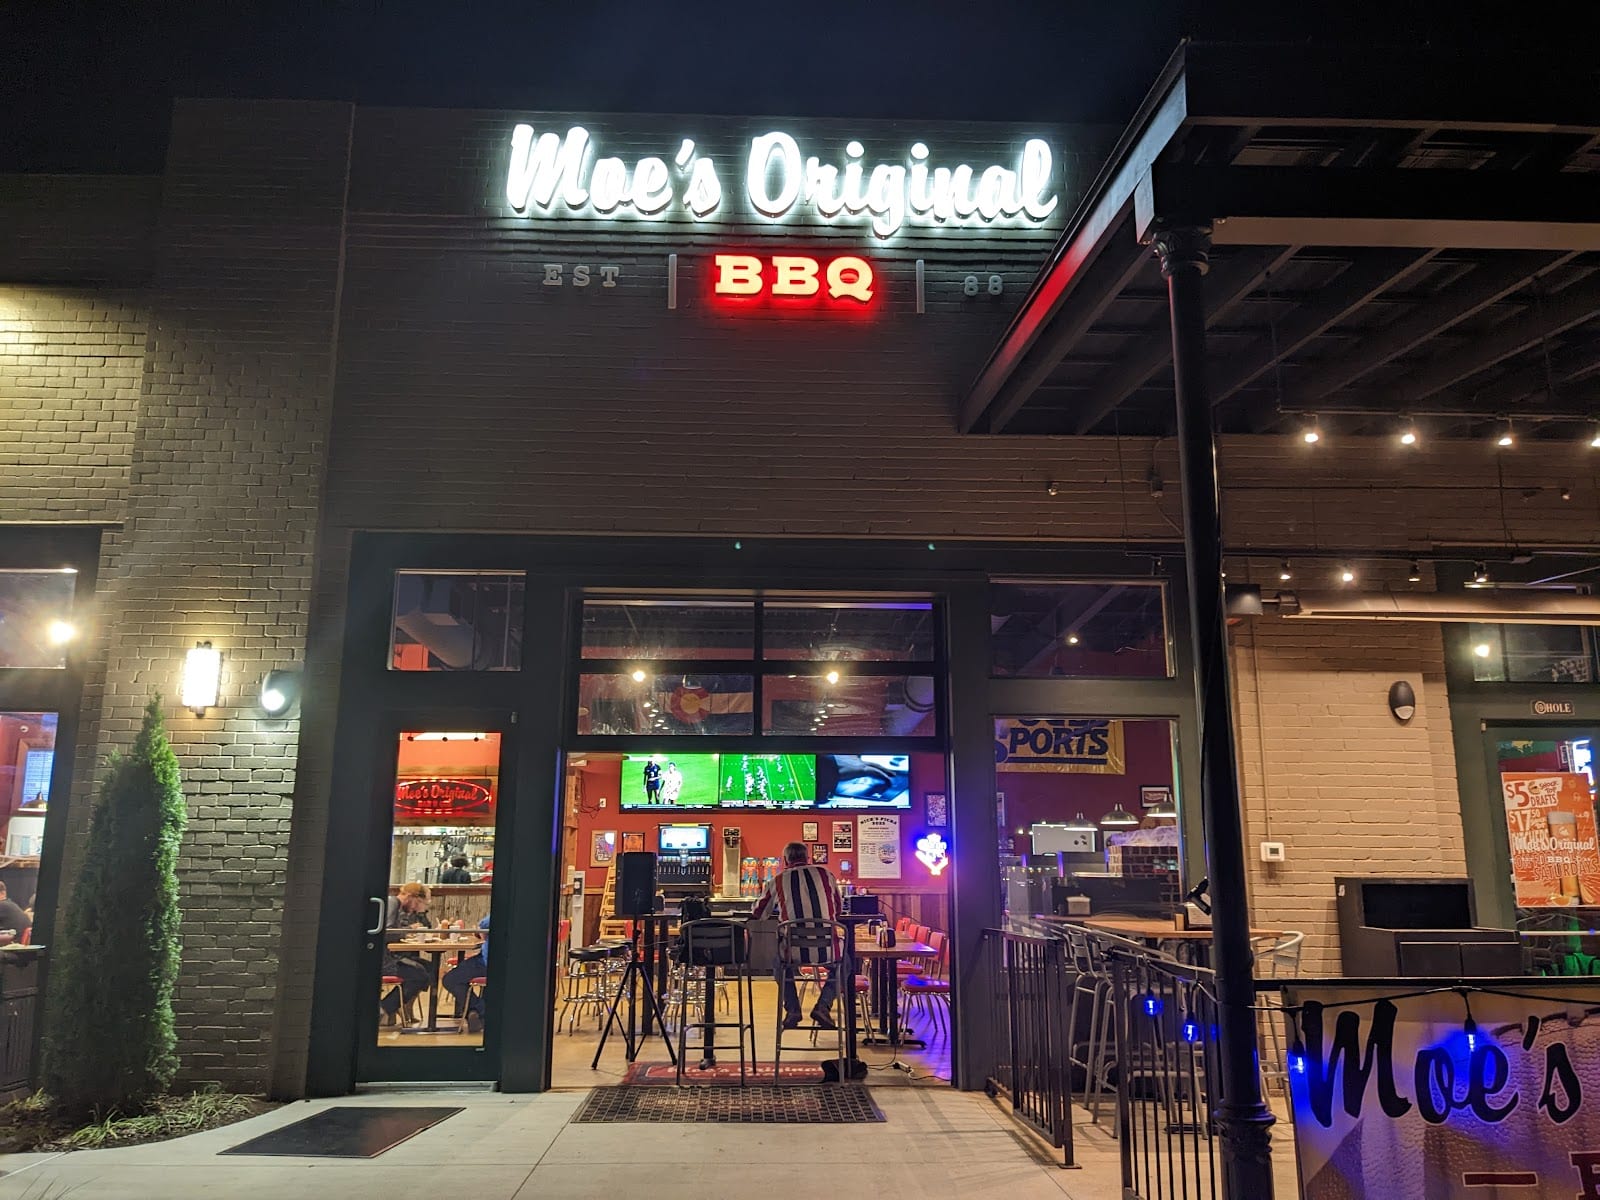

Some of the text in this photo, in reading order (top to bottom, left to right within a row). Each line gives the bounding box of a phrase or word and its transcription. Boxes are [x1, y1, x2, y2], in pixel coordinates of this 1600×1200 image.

[505, 123, 1058, 239] Moe's Original
[542, 264, 620, 288] EST
[714, 254, 874, 302] BBQ
[963, 275, 1004, 296] 88
[396, 784, 478, 801] Moe's Original
[1505, 782, 1530, 807] $5
[1530, 794, 1557, 807] DRAFTS
[1550, 836, 1596, 853] Original
[1533, 859, 1599, 881] SATURDAYS
[1301, 1000, 1582, 1128] Moe's
